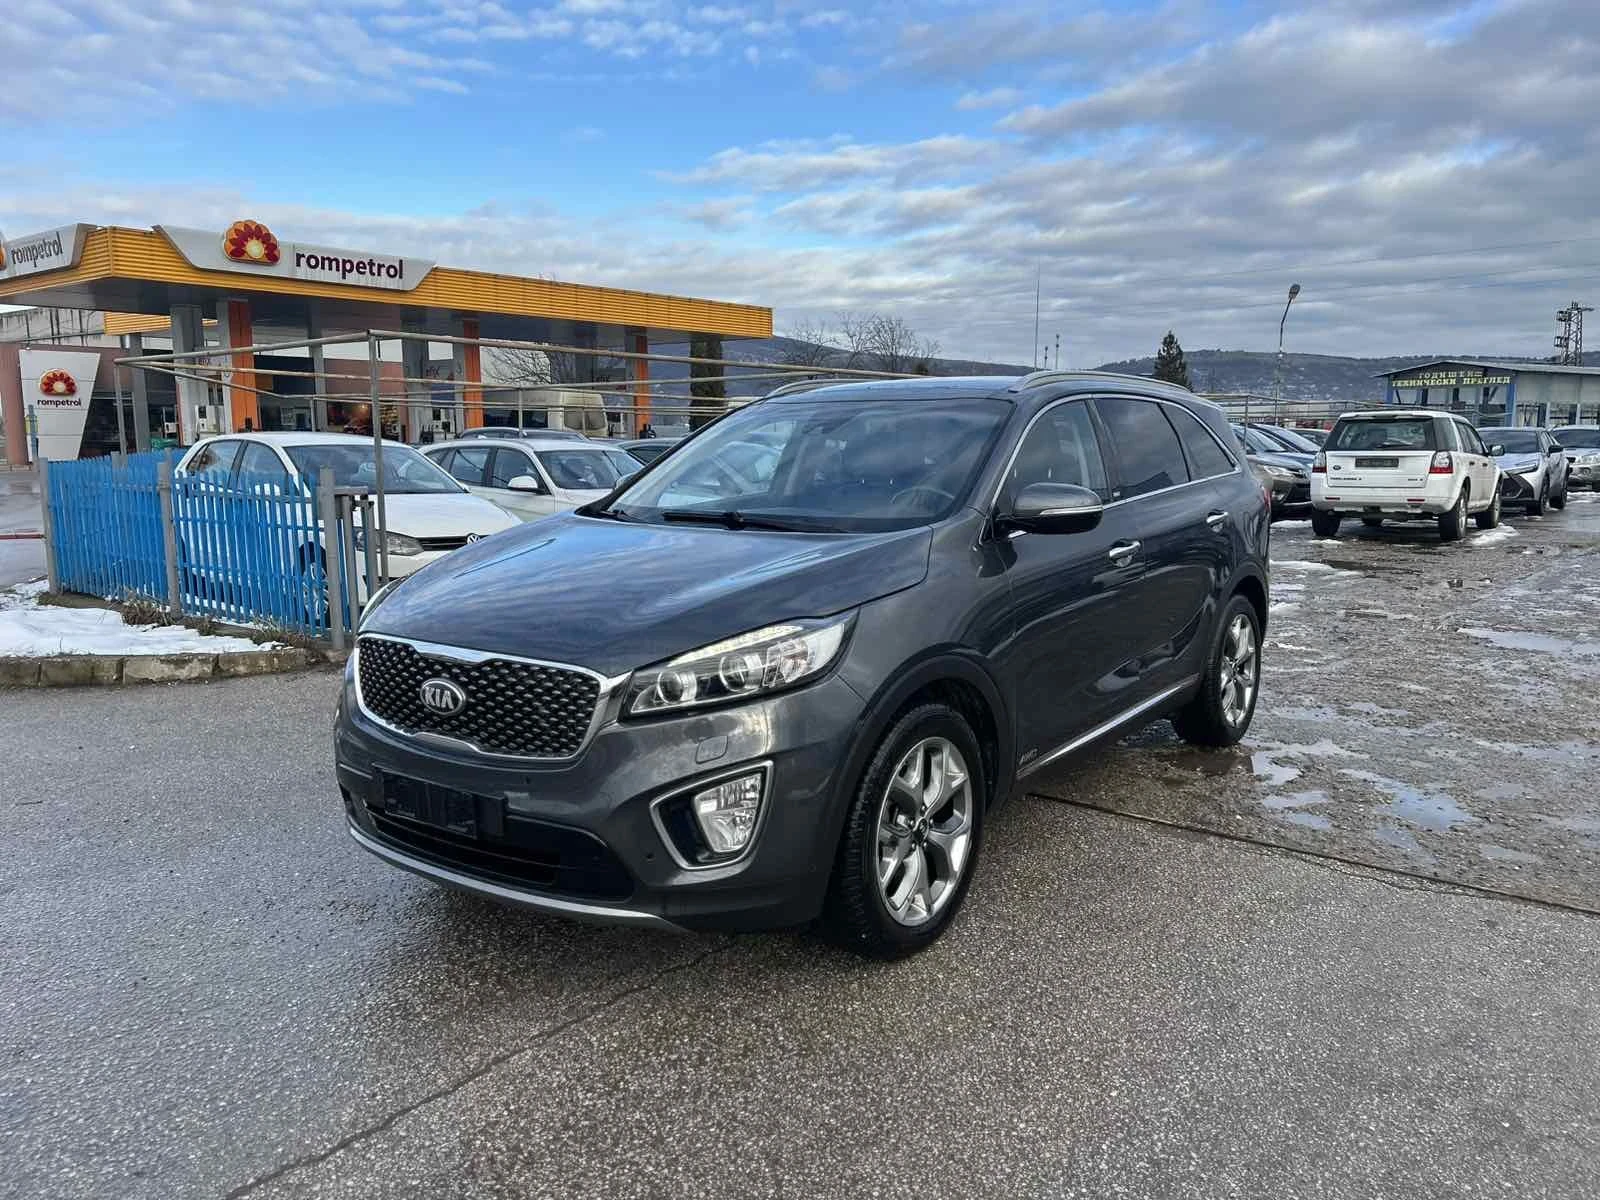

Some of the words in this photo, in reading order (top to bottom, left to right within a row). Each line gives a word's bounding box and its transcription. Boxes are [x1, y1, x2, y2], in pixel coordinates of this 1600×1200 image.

[11, 231, 63, 268] rompetrol
[295, 252, 403, 279] rompetrol
[37, 397, 81, 408] rompetrol
[424, 686, 454, 709] KIA
